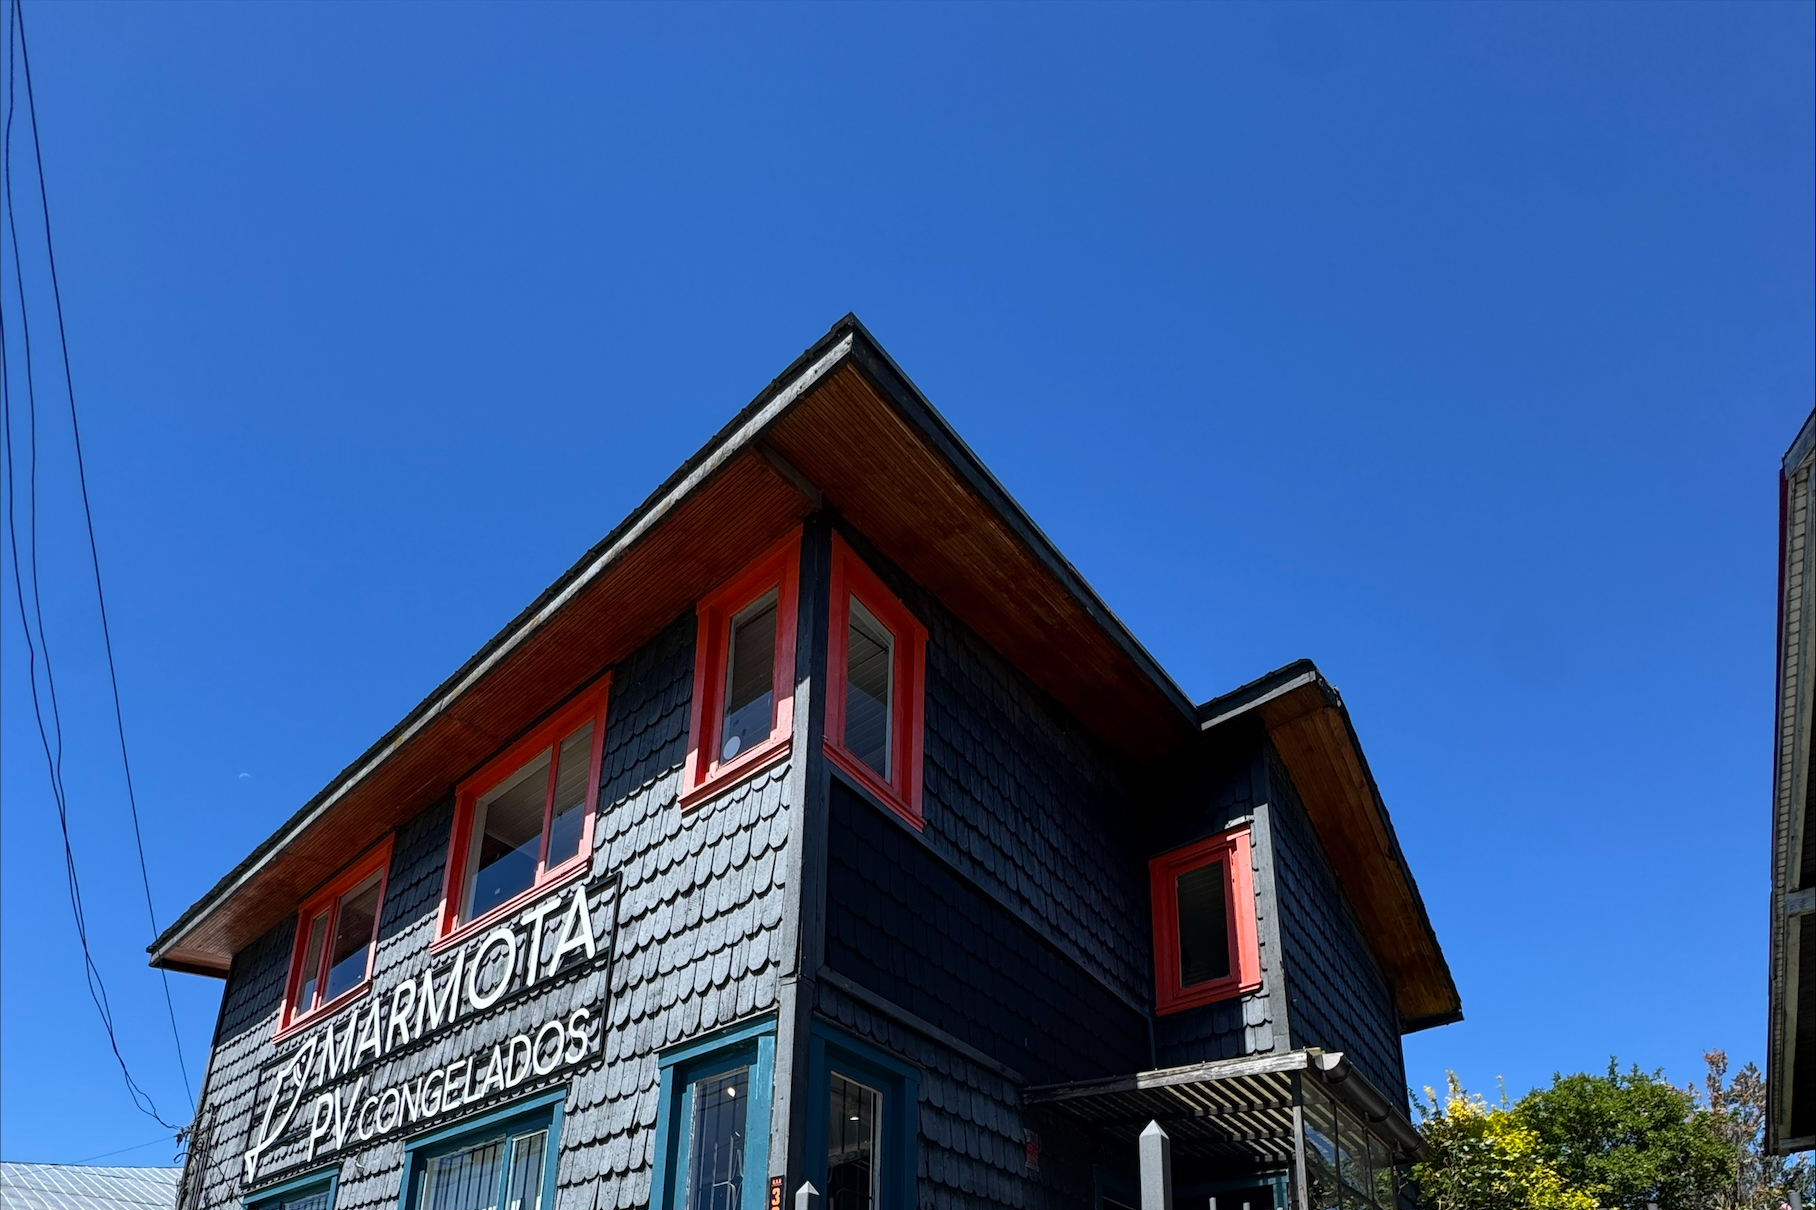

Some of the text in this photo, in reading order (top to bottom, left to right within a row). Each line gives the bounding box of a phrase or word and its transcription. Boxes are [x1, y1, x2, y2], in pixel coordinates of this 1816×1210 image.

[318, 884, 596, 1086] MARMOTA
[307, 1007, 590, 1162] PV CONGELADOS
